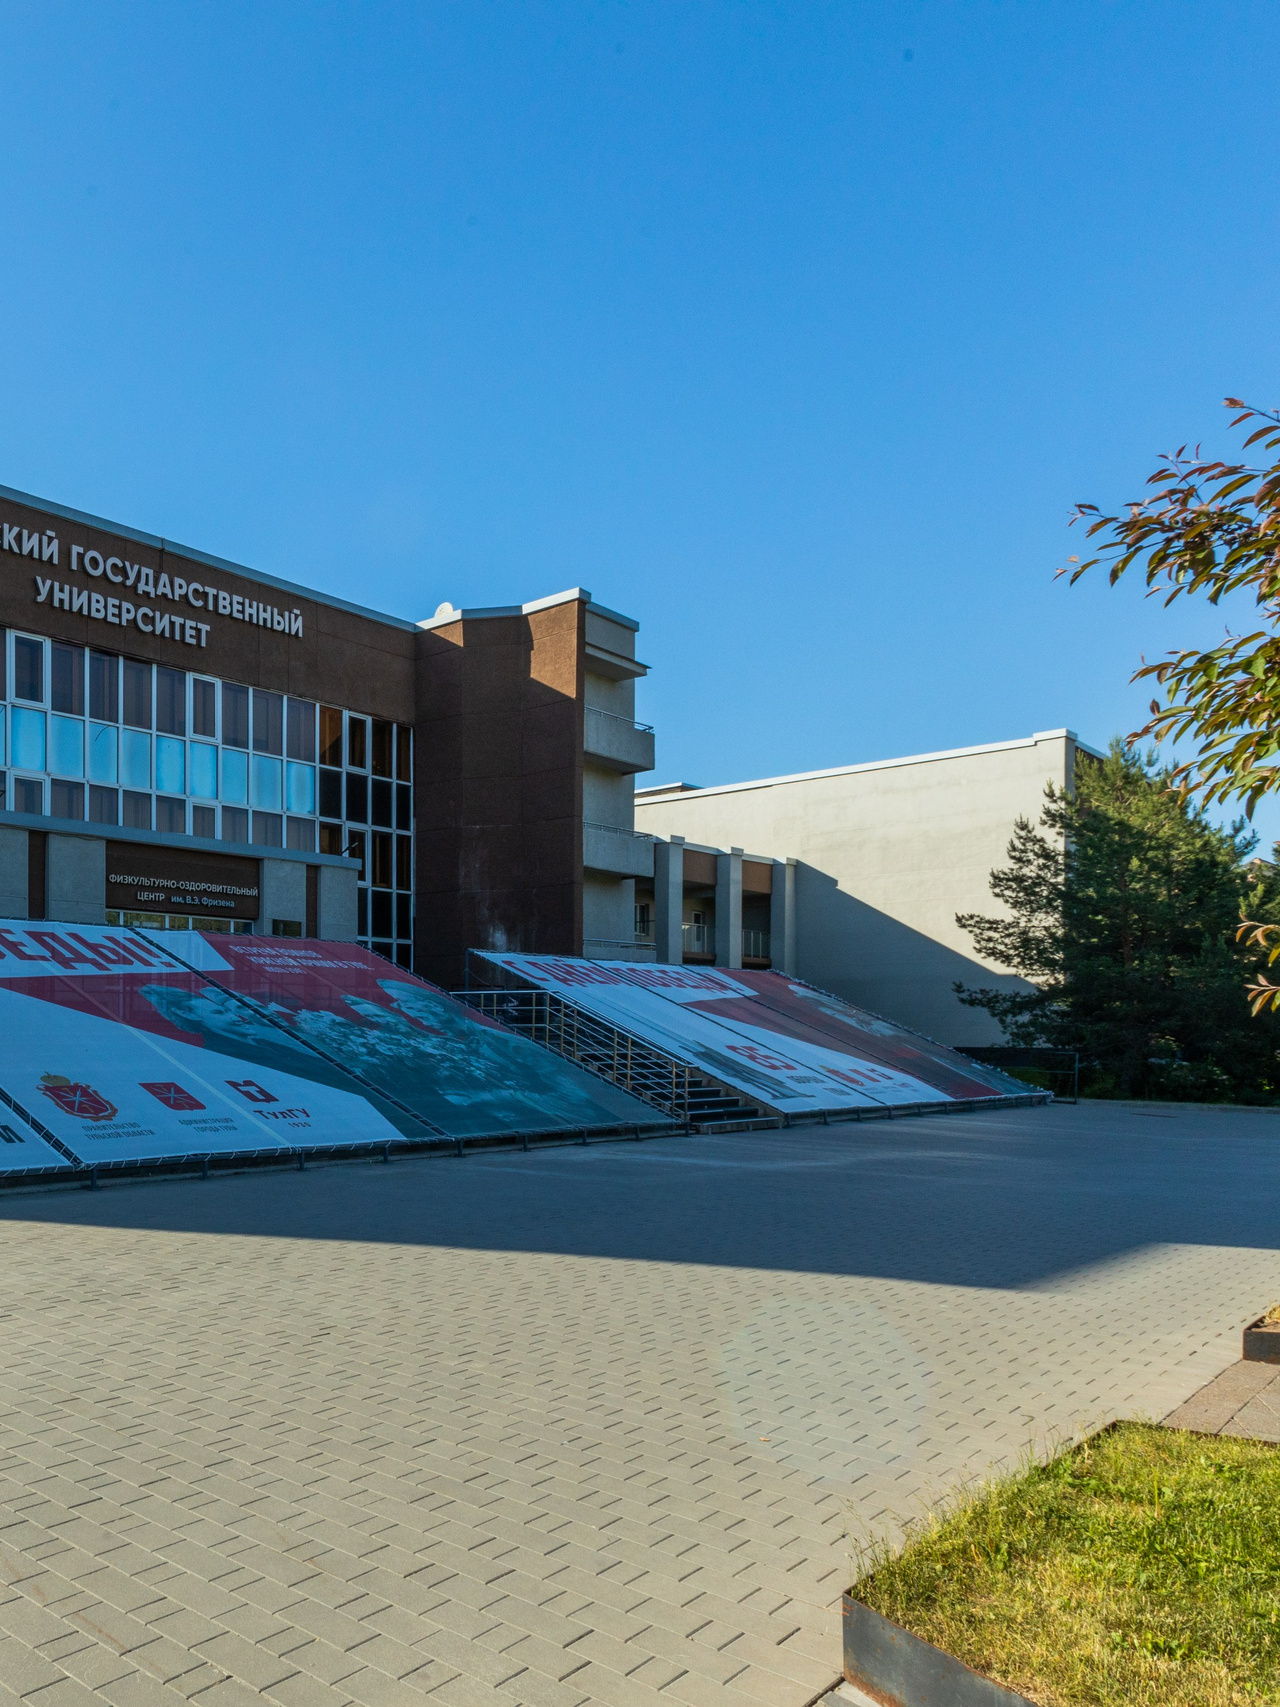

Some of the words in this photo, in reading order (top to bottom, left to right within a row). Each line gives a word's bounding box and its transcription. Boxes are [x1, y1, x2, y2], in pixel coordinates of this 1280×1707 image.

[70, 544, 304, 638] ГОСУДАРСТВЕННЫЙ
[34, 575, 210, 648] УНИВЕРСИТЕТ
[108, 873, 258, 897] ФИЗКУЛЬТУРНО-ОЗДОРОВИТЕЛЬНЫЙ
[137, 891, 165, 902] ЦЕНТР
[171, 896, 185, 904] им.
[201, 896, 235, 908] Фризена
[725, 1045, 798, 1071] 85
